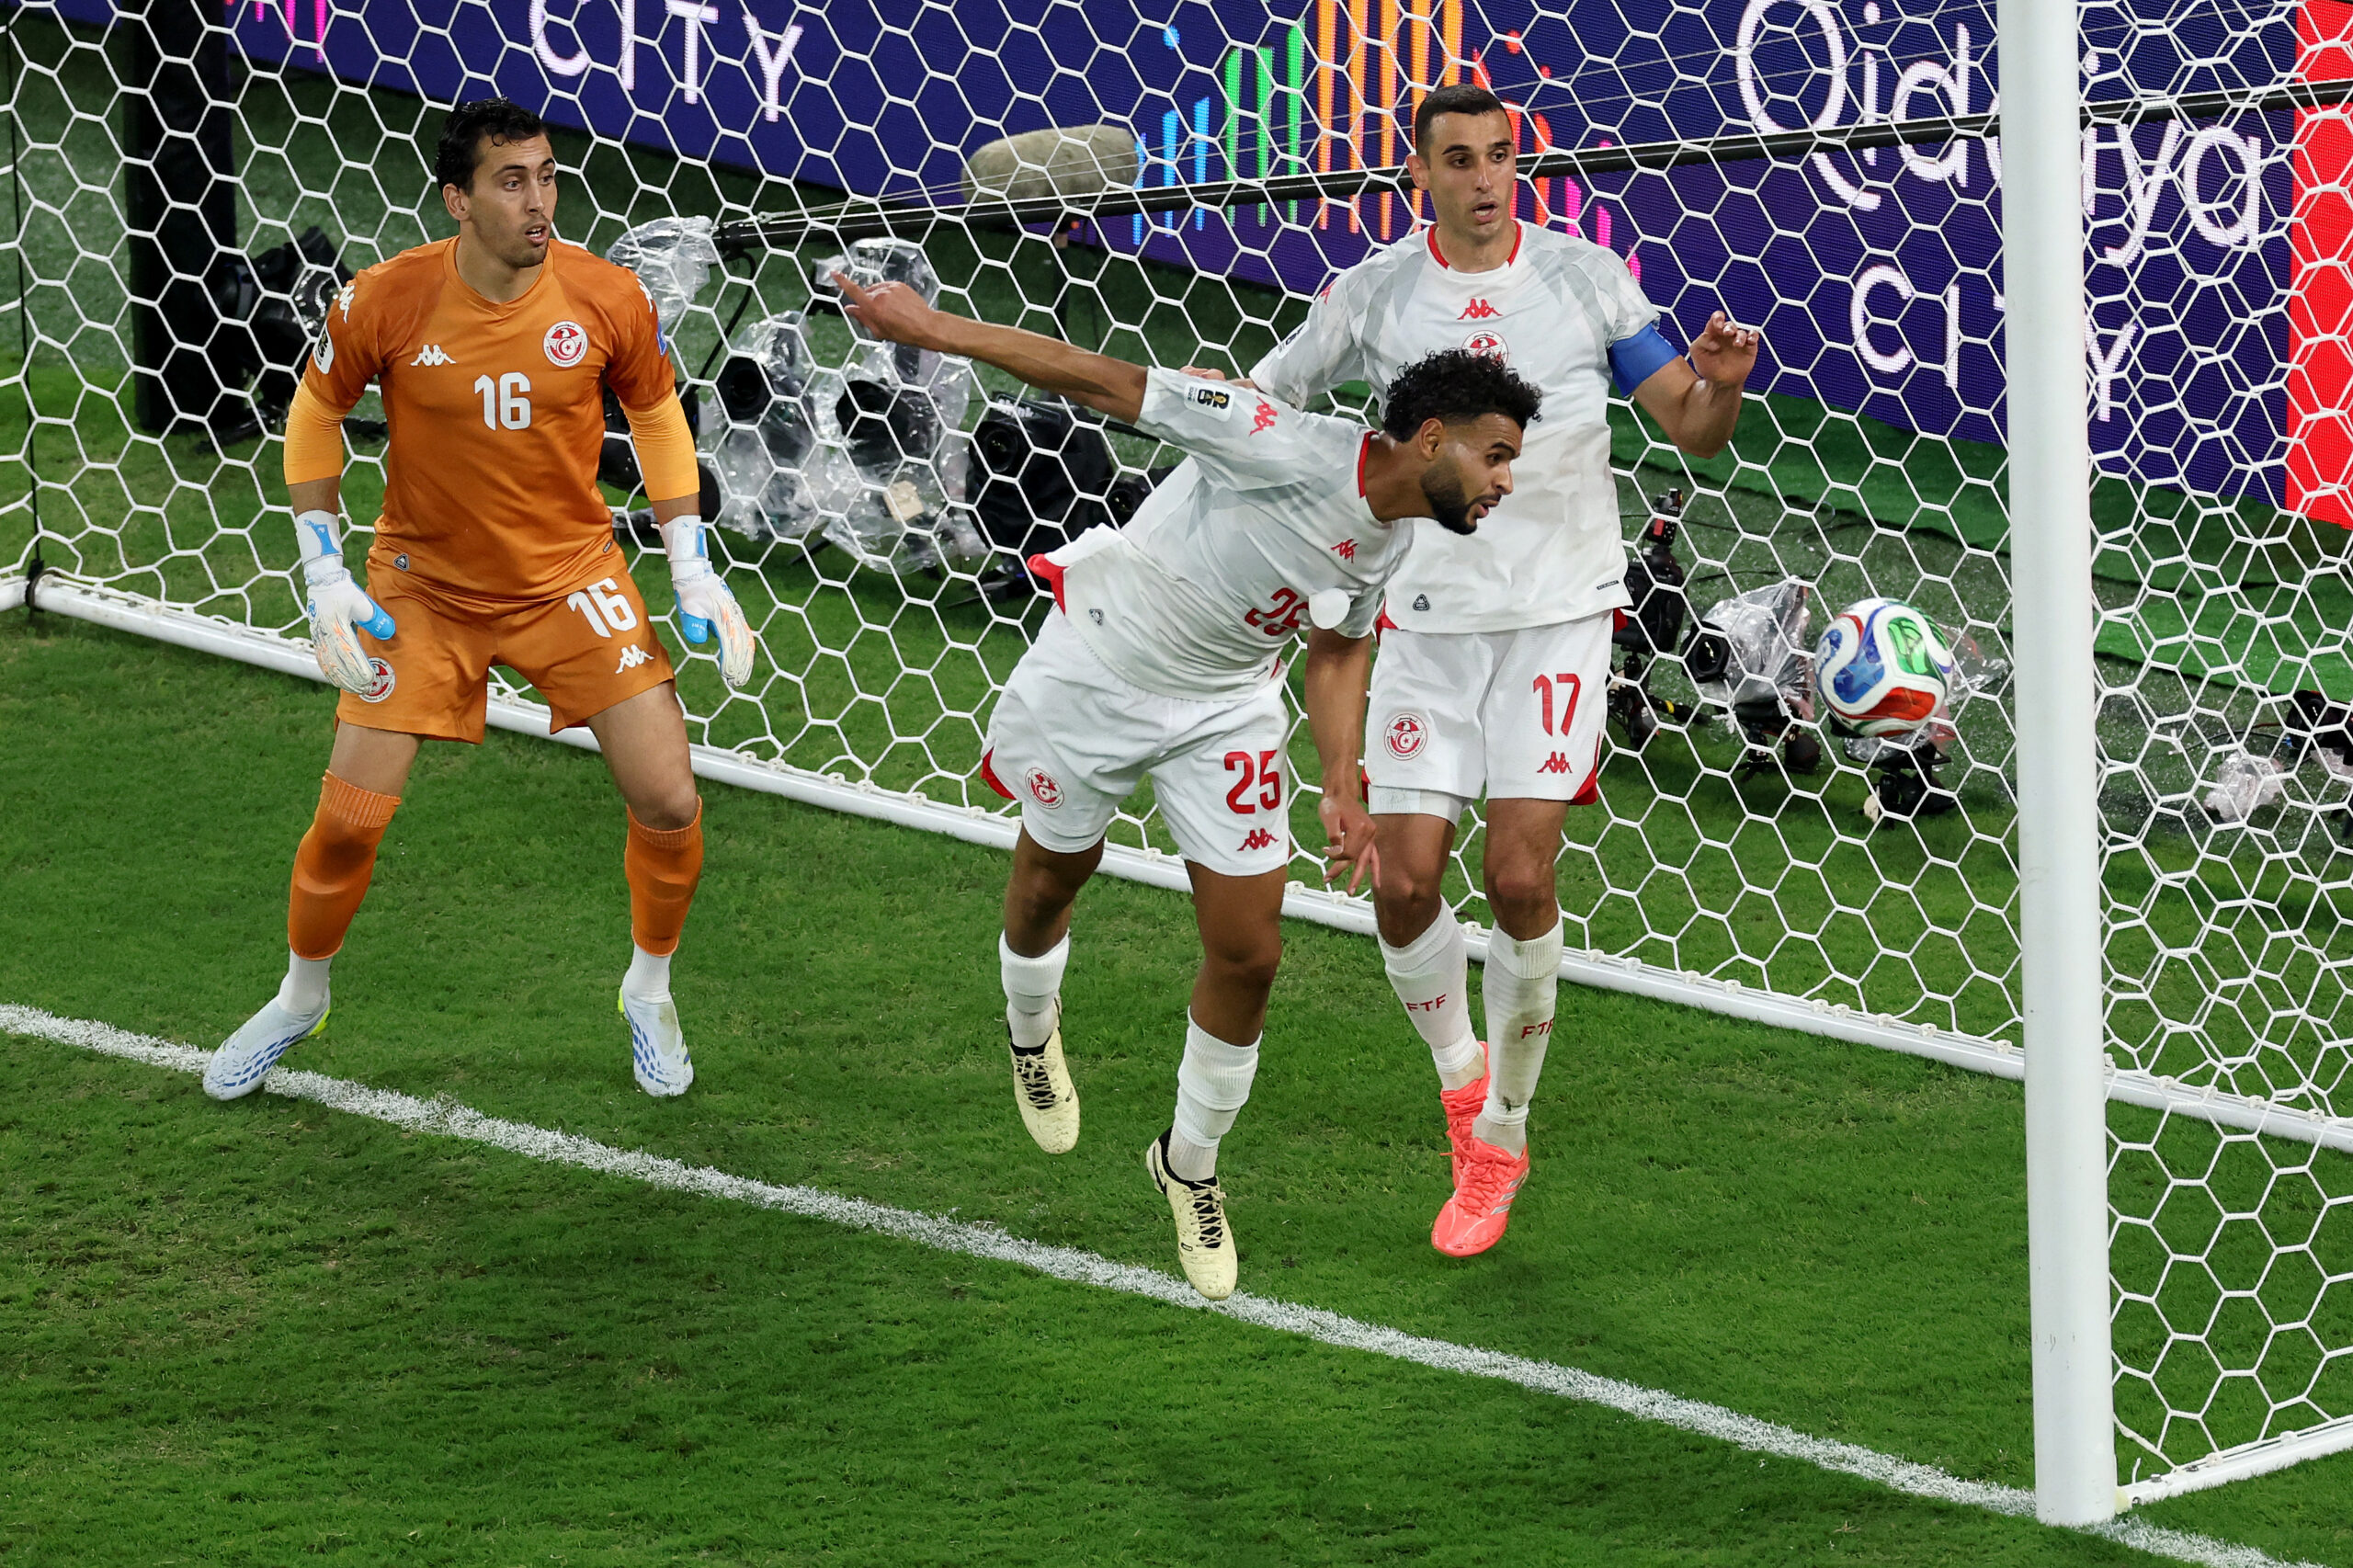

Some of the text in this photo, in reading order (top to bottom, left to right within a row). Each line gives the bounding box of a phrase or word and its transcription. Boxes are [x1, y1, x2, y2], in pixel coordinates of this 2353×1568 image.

[529, 0, 804, 122] CITY
[1735, 0, 2261, 267] Qidiya
[1850, 264, 2139, 422] CIY
[474, 371, 531, 431] 16
[566, 577, 638, 638] 16
[1533, 673, 1581, 737] 17
[1224, 749, 1280, 814] 25
[1405, 994, 1447, 1012] FTF
